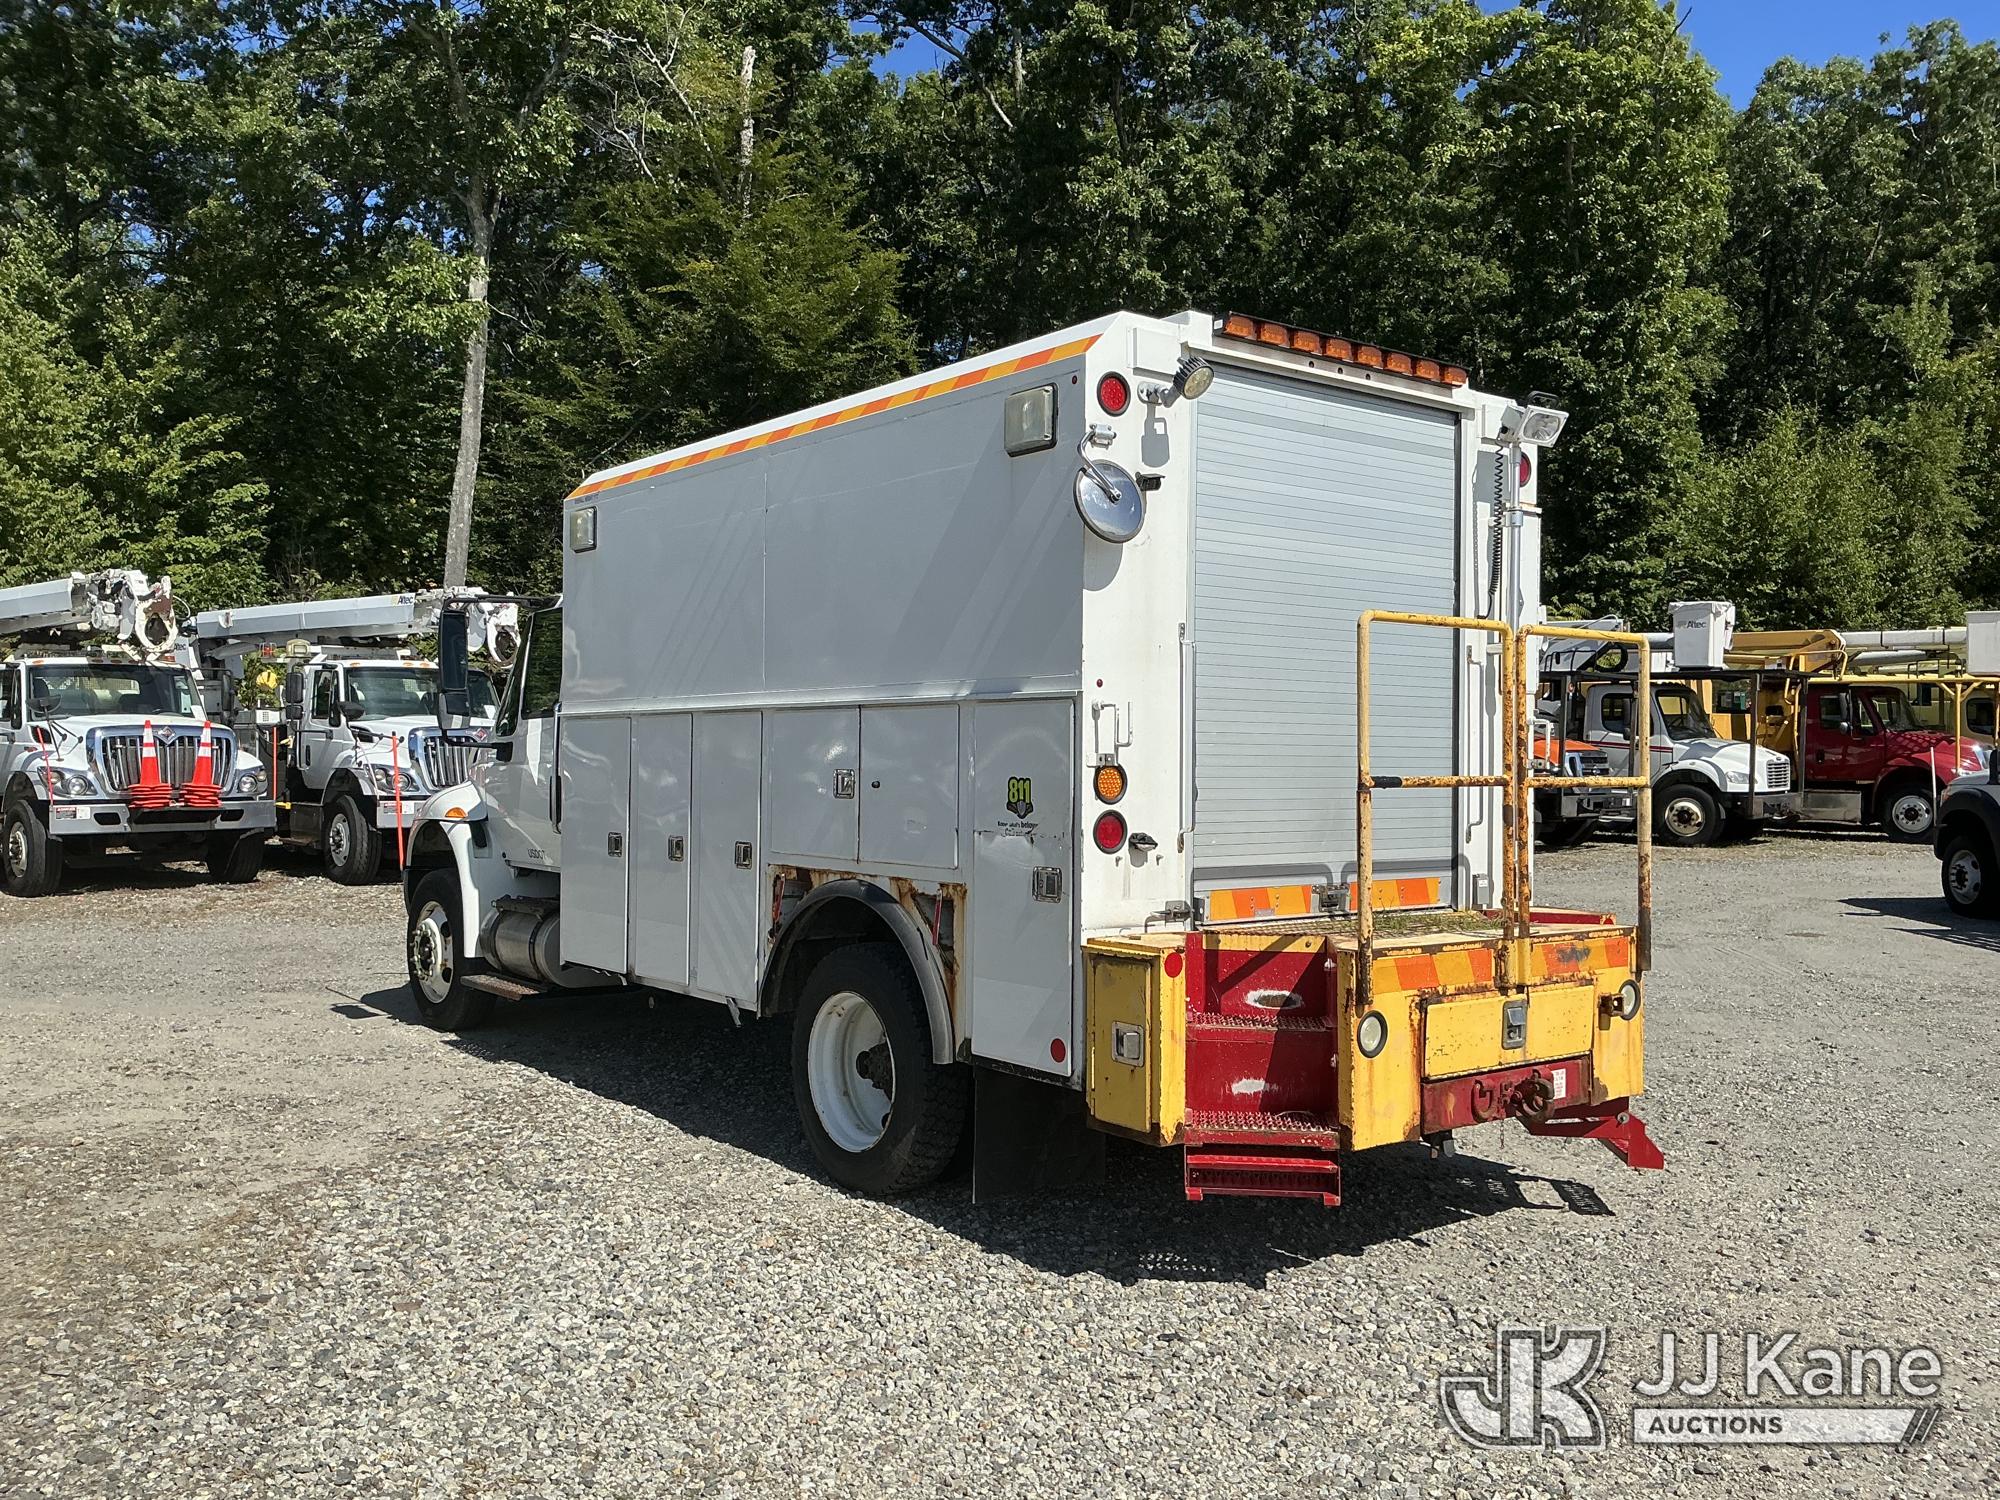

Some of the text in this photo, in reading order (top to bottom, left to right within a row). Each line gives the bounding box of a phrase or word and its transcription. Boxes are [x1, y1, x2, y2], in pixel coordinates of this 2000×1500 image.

[397, 595, 414, 605] Altec
[1687, 620, 1707, 629] Altec
[1008, 777, 1031, 804] 811
